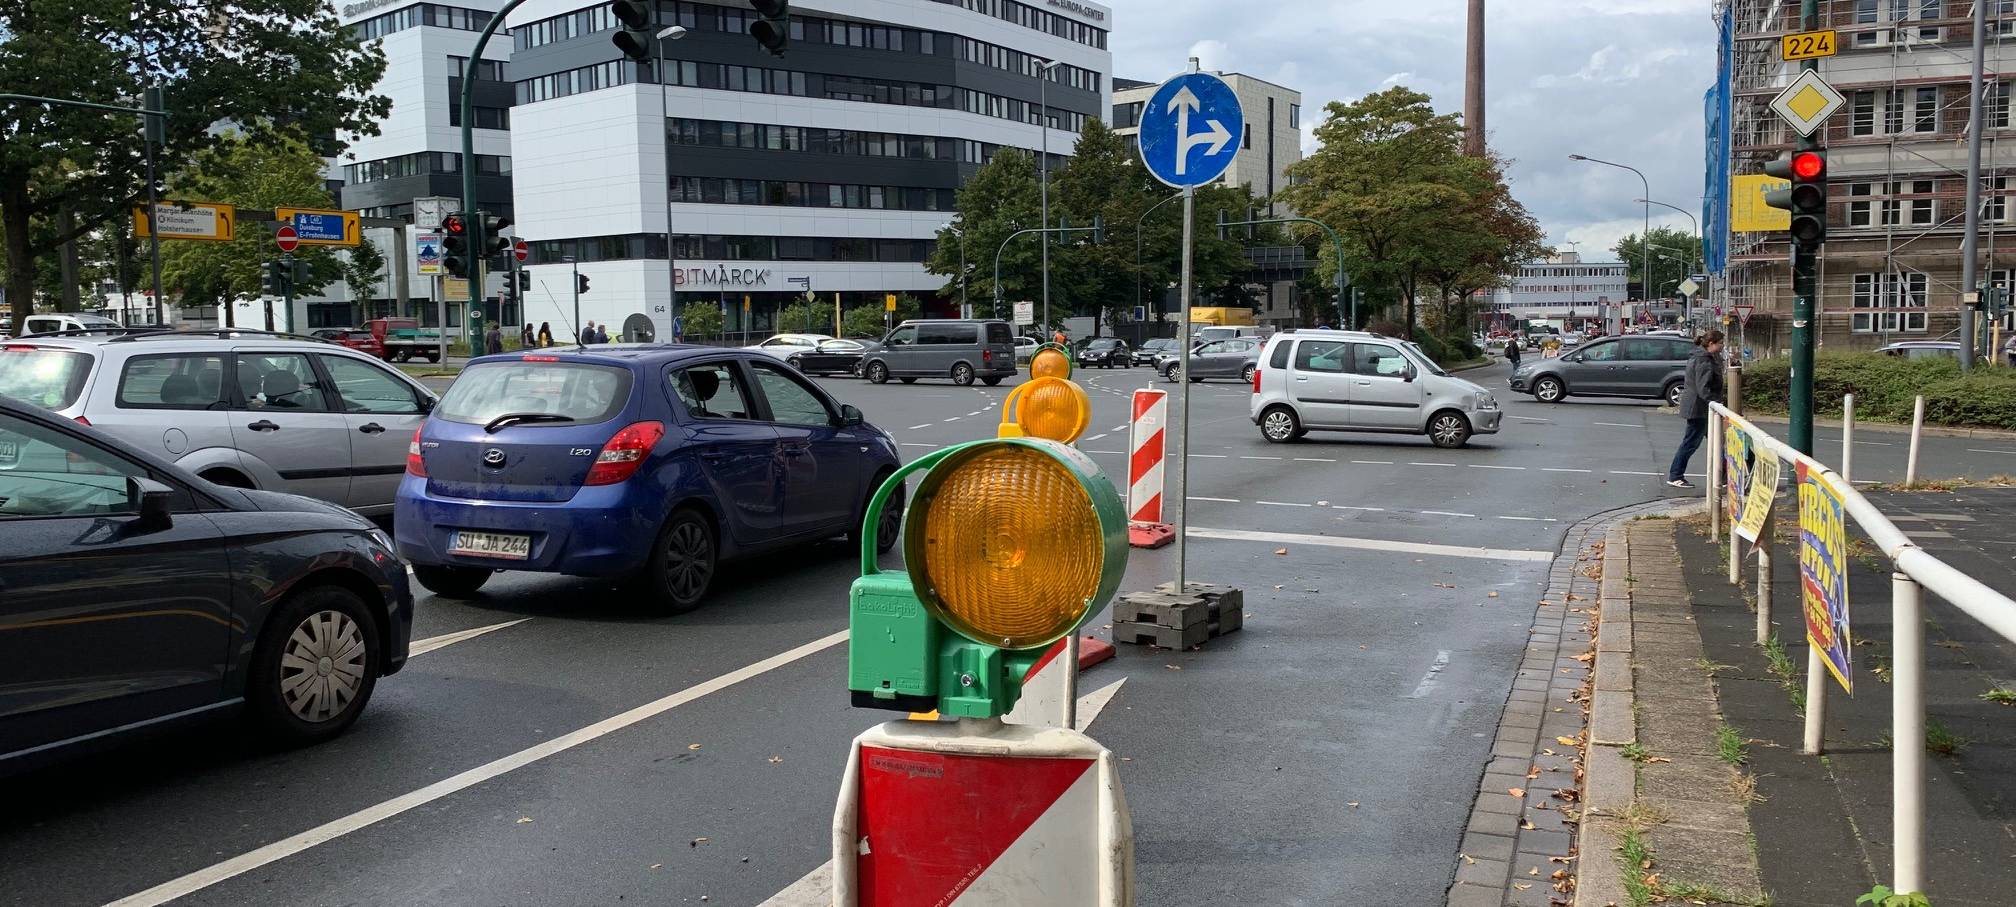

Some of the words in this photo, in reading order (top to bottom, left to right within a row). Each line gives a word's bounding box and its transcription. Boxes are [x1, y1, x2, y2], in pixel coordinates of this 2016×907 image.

[1789, 35, 1829, 56] 224
[166, 217, 194, 225] Klinikum
[300, 224, 323, 233] Duisburg
[673, 268, 766, 285] BITMARCK
[457, 532, 474, 549] SU
[482, 536, 498, 551] JA
[502, 536, 528, 554] 244
